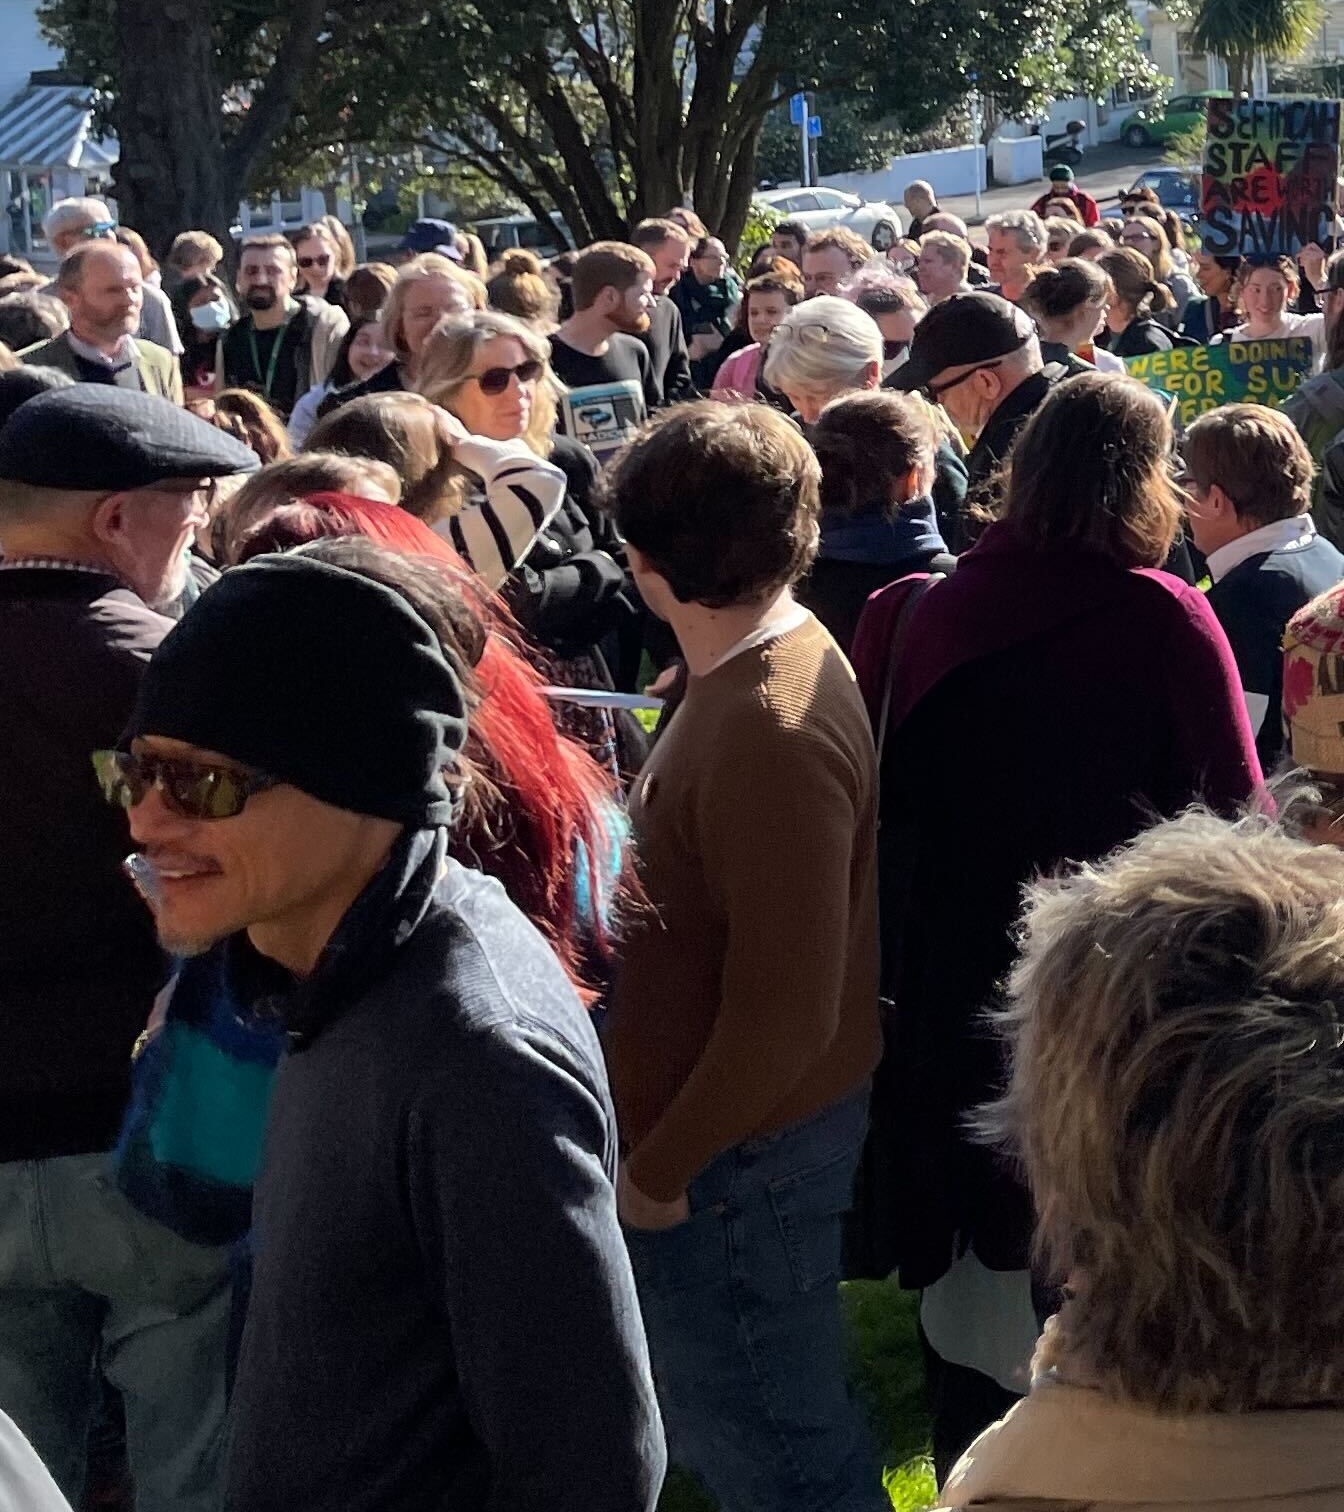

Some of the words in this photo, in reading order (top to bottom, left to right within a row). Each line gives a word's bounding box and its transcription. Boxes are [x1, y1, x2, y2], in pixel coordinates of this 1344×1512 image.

[1203, 141, 1332, 178] STAFF
[1203, 176, 1271, 206] ARE
[1165, 369, 1225, 396] FOR
